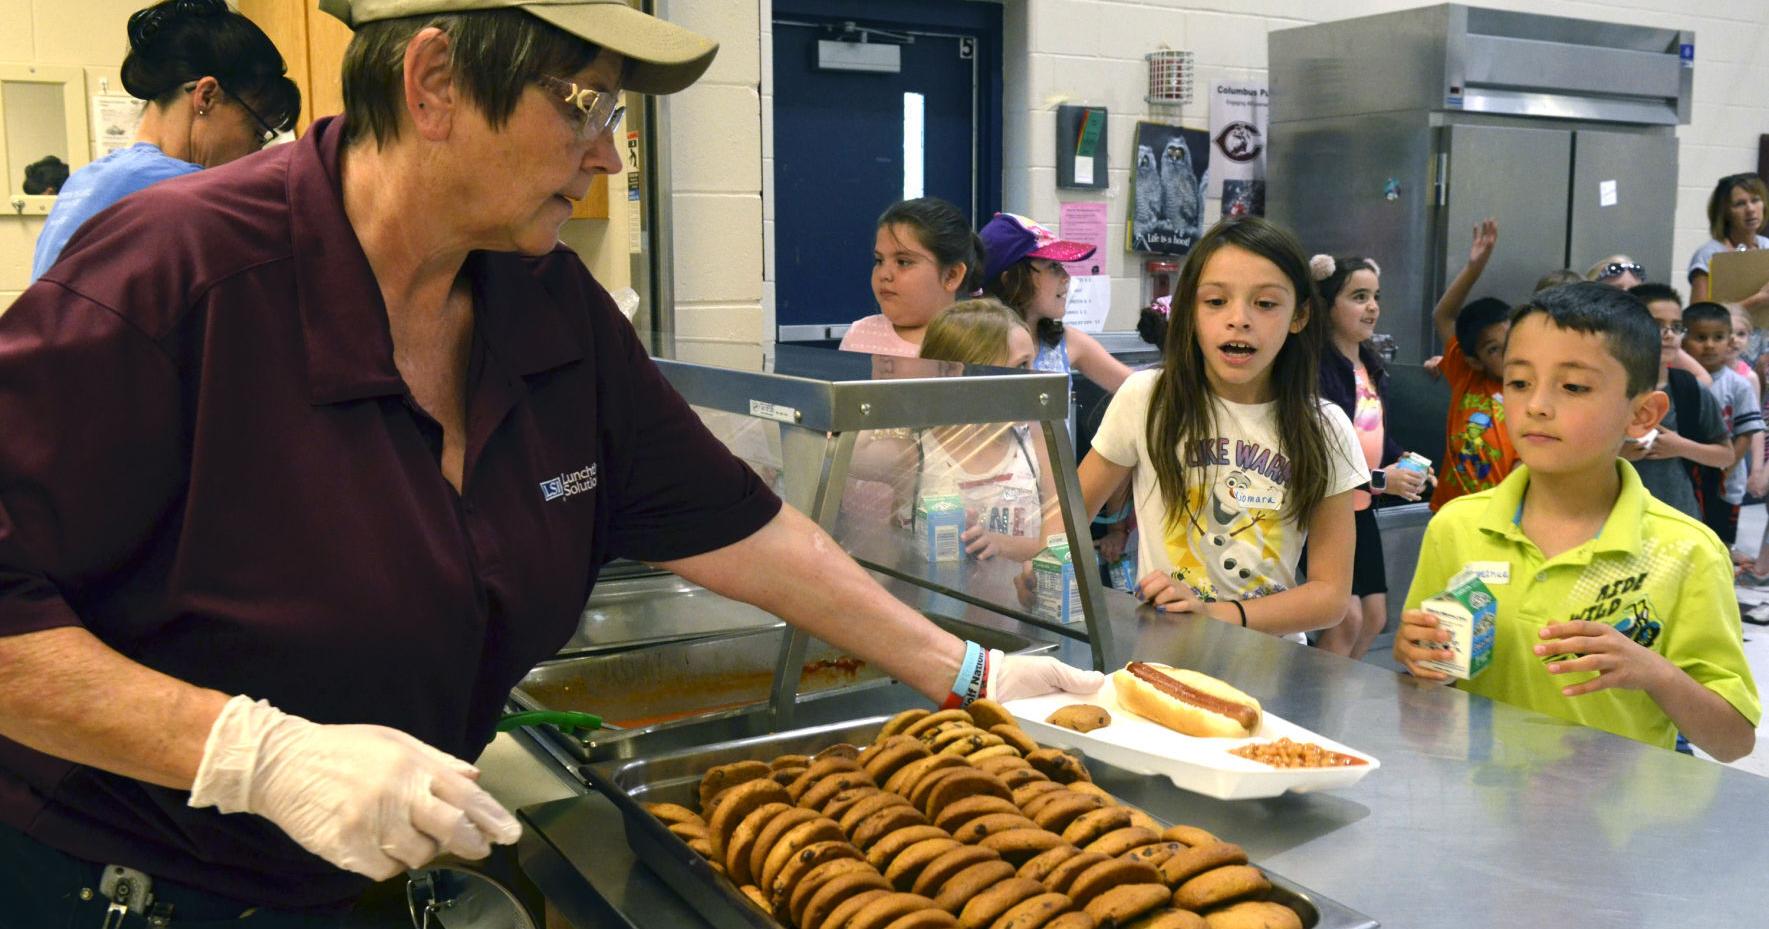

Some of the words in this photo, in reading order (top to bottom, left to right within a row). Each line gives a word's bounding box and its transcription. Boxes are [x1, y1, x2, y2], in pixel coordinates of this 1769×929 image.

[962, 38, 974, 56] 5
[1217, 84, 1257, 97] Columbus
[1147, 232, 1160, 243] Life
[1173, 234, 1192, 248] hoot!
[543, 480, 562, 498] LSI
[1595, 572, 1649, 602] RIDE
[970, 652, 985, 686] Nation
